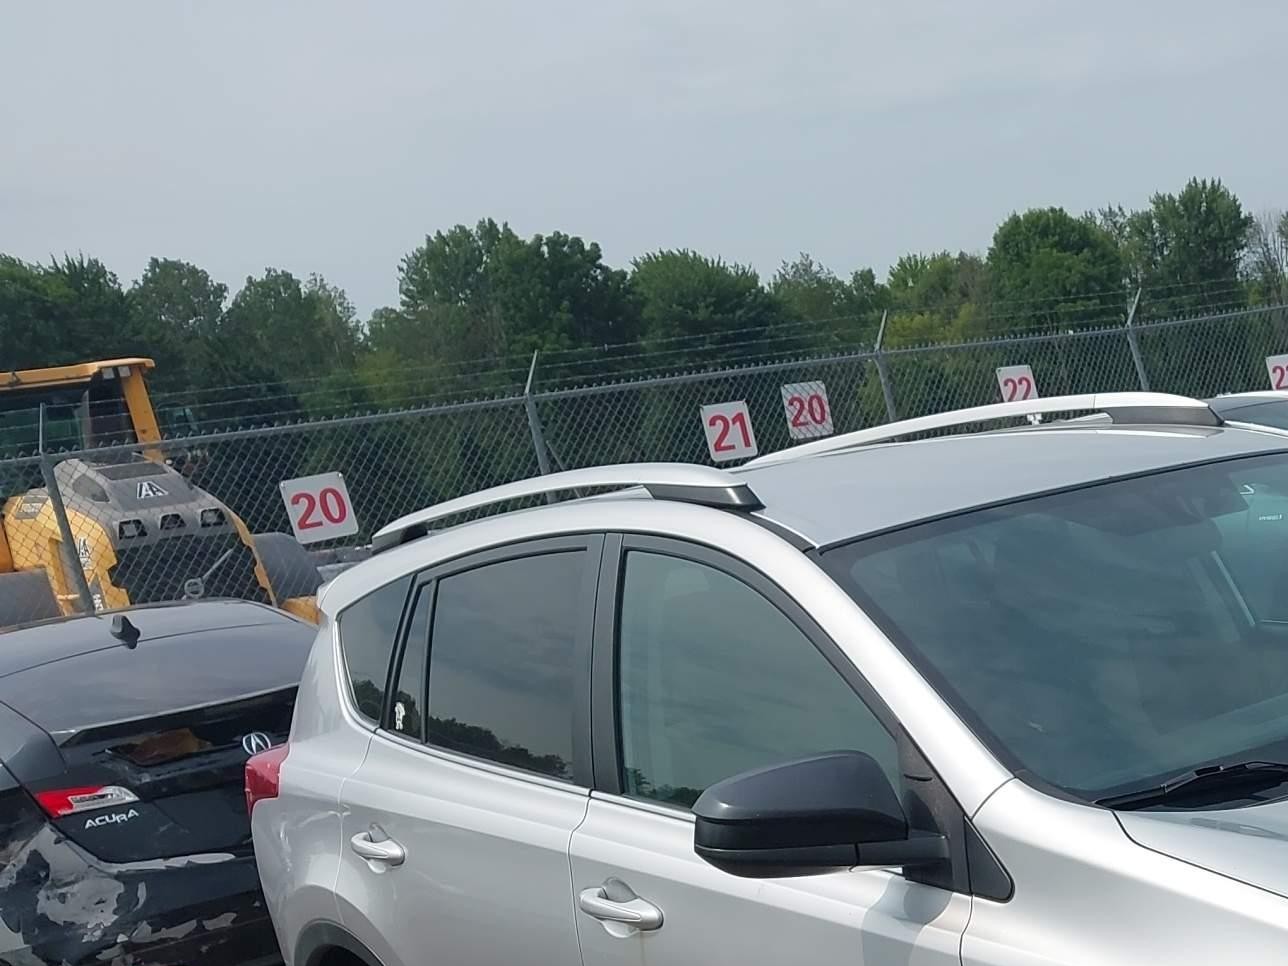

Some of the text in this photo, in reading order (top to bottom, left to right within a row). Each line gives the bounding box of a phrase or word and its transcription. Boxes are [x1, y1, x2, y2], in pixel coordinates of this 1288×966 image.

[1003, 376, 1032, 402] 22
[788, 394, 826, 428] 20
[708, 411, 752, 452] 21
[291, 487, 347, 530] 20
[84, 808, 139, 829] ACURA
